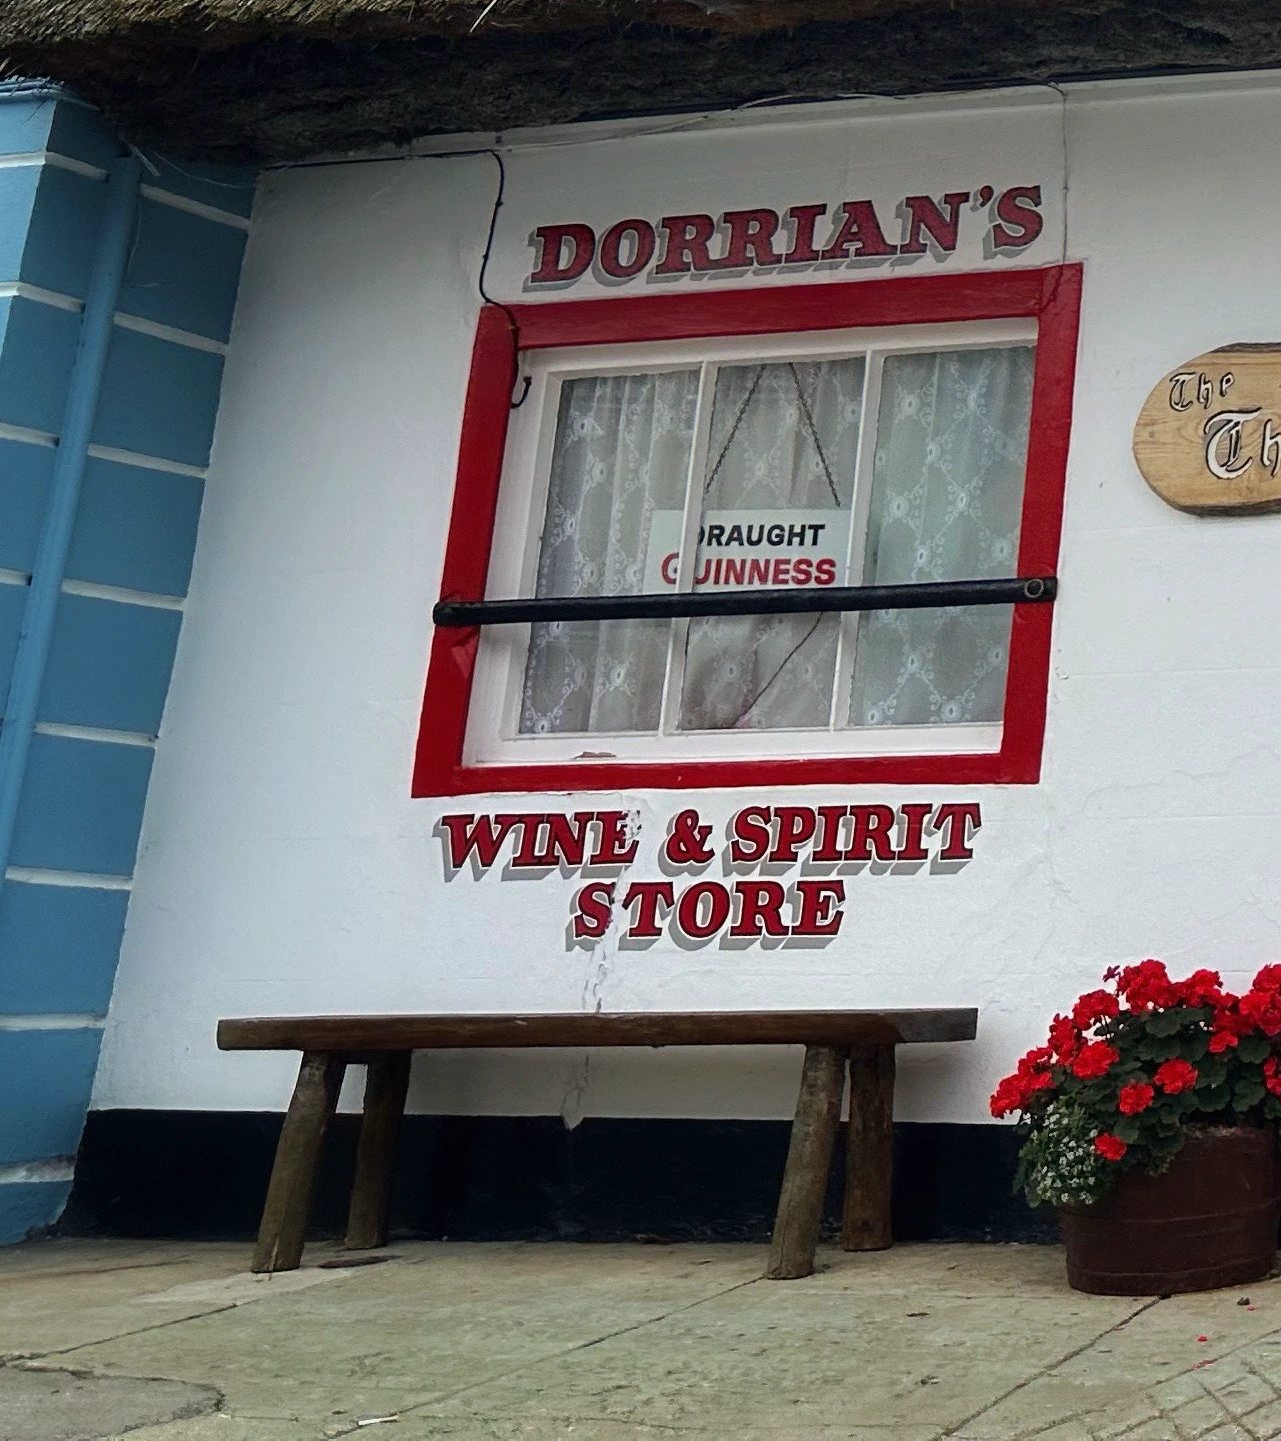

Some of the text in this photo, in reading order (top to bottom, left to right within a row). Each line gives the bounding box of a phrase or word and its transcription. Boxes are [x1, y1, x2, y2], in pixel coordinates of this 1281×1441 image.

[529, 184, 1044, 285] DORRIAN'S
[1168, 371, 1235, 412] The
[439, 802, 983, 870] WINE & SPIRIT
[573, 878, 847, 939] STORE
